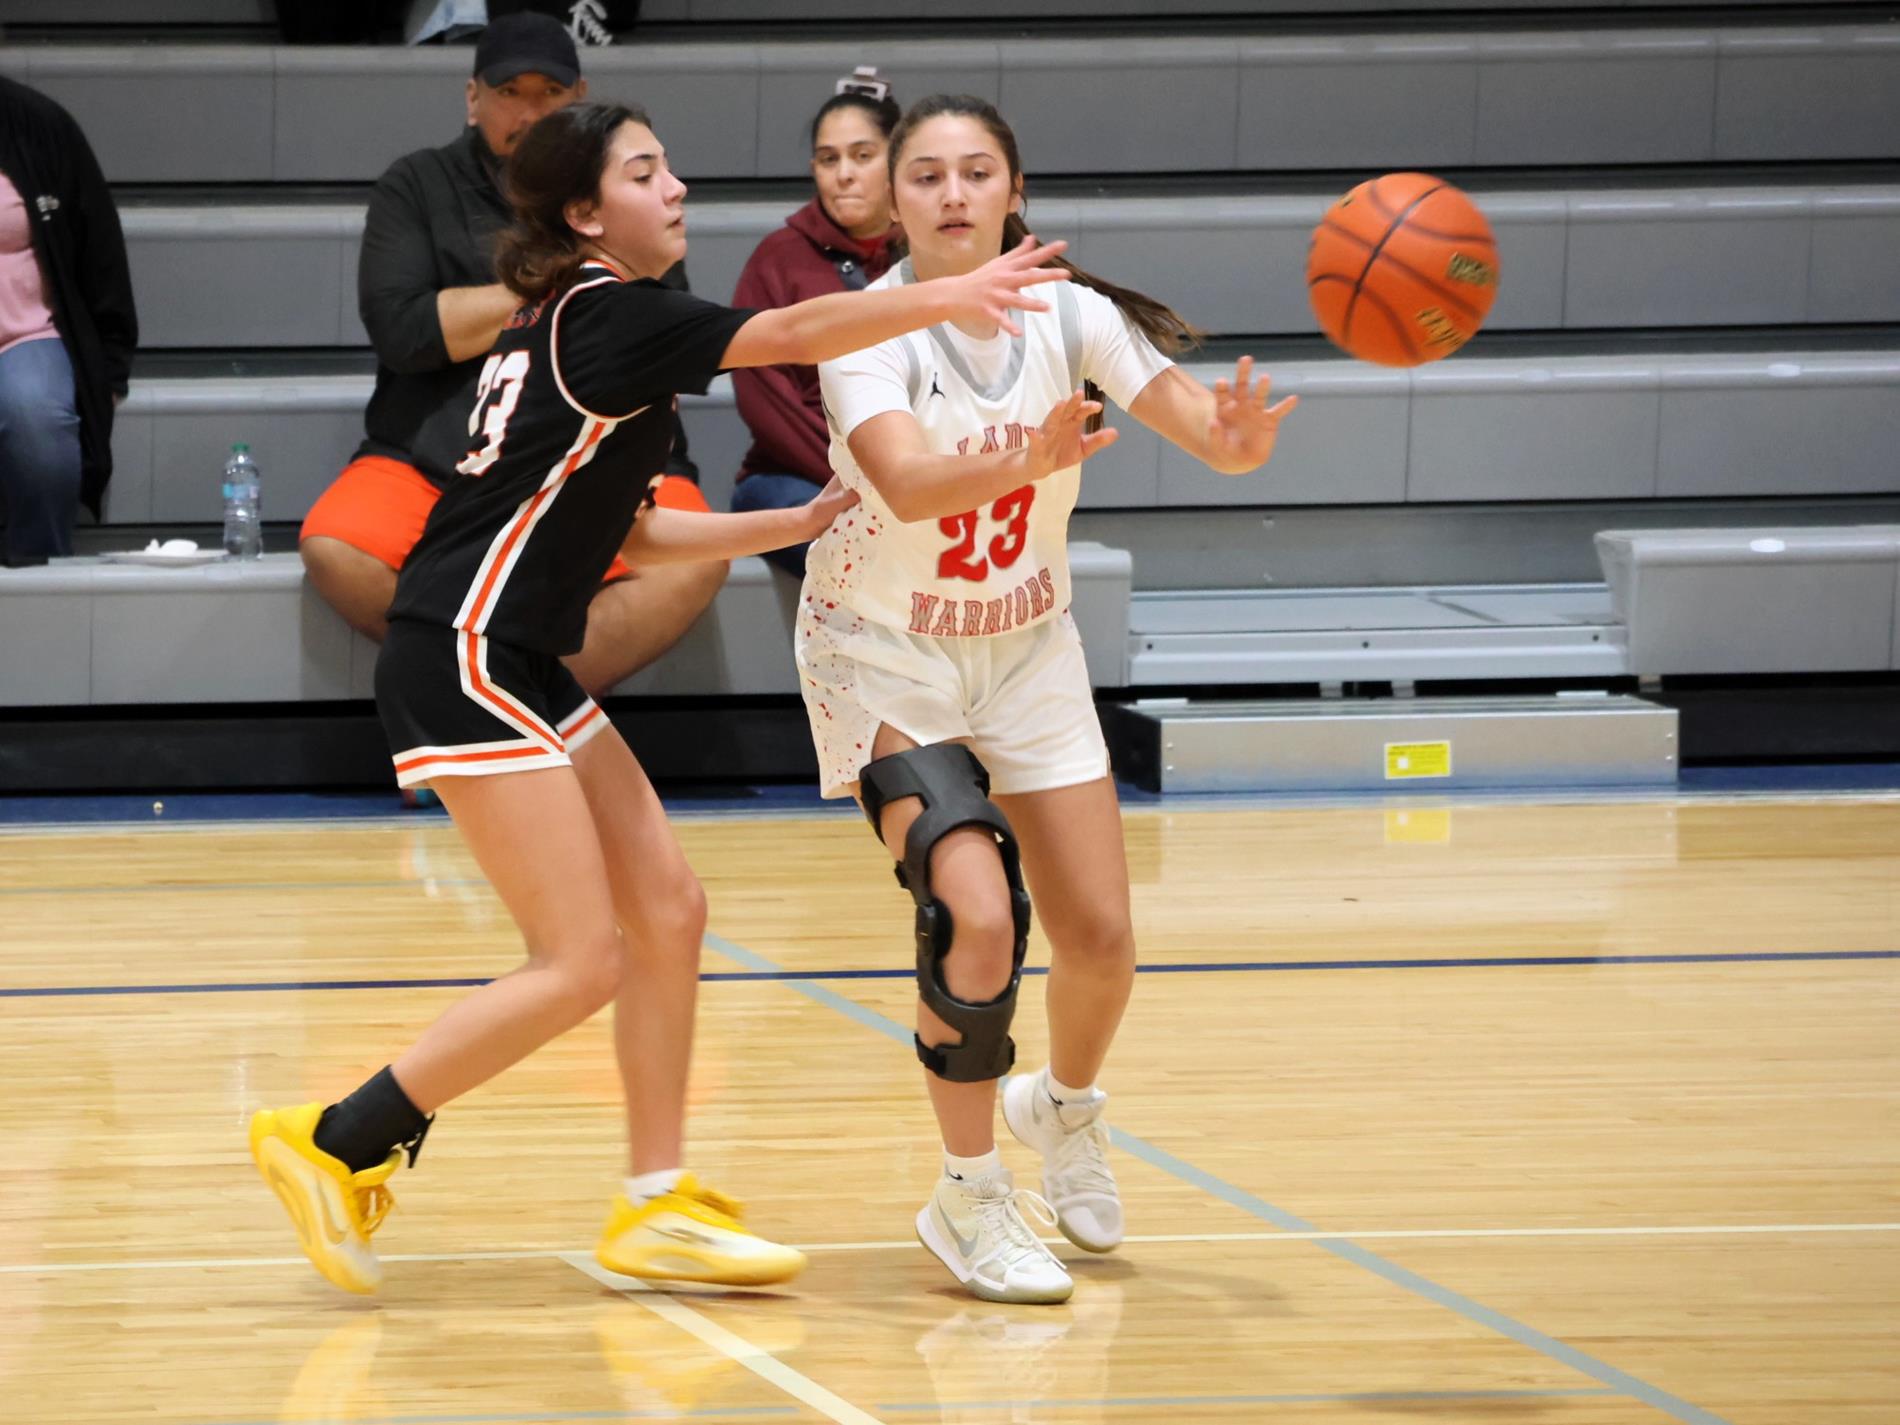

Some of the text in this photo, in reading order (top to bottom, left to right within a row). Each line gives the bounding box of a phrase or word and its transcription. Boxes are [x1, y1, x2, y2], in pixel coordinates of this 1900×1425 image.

[957, 422, 1040, 456] AD
[937, 484, 1035, 582] 23
[908, 568, 1056, 637] WARRIORS
